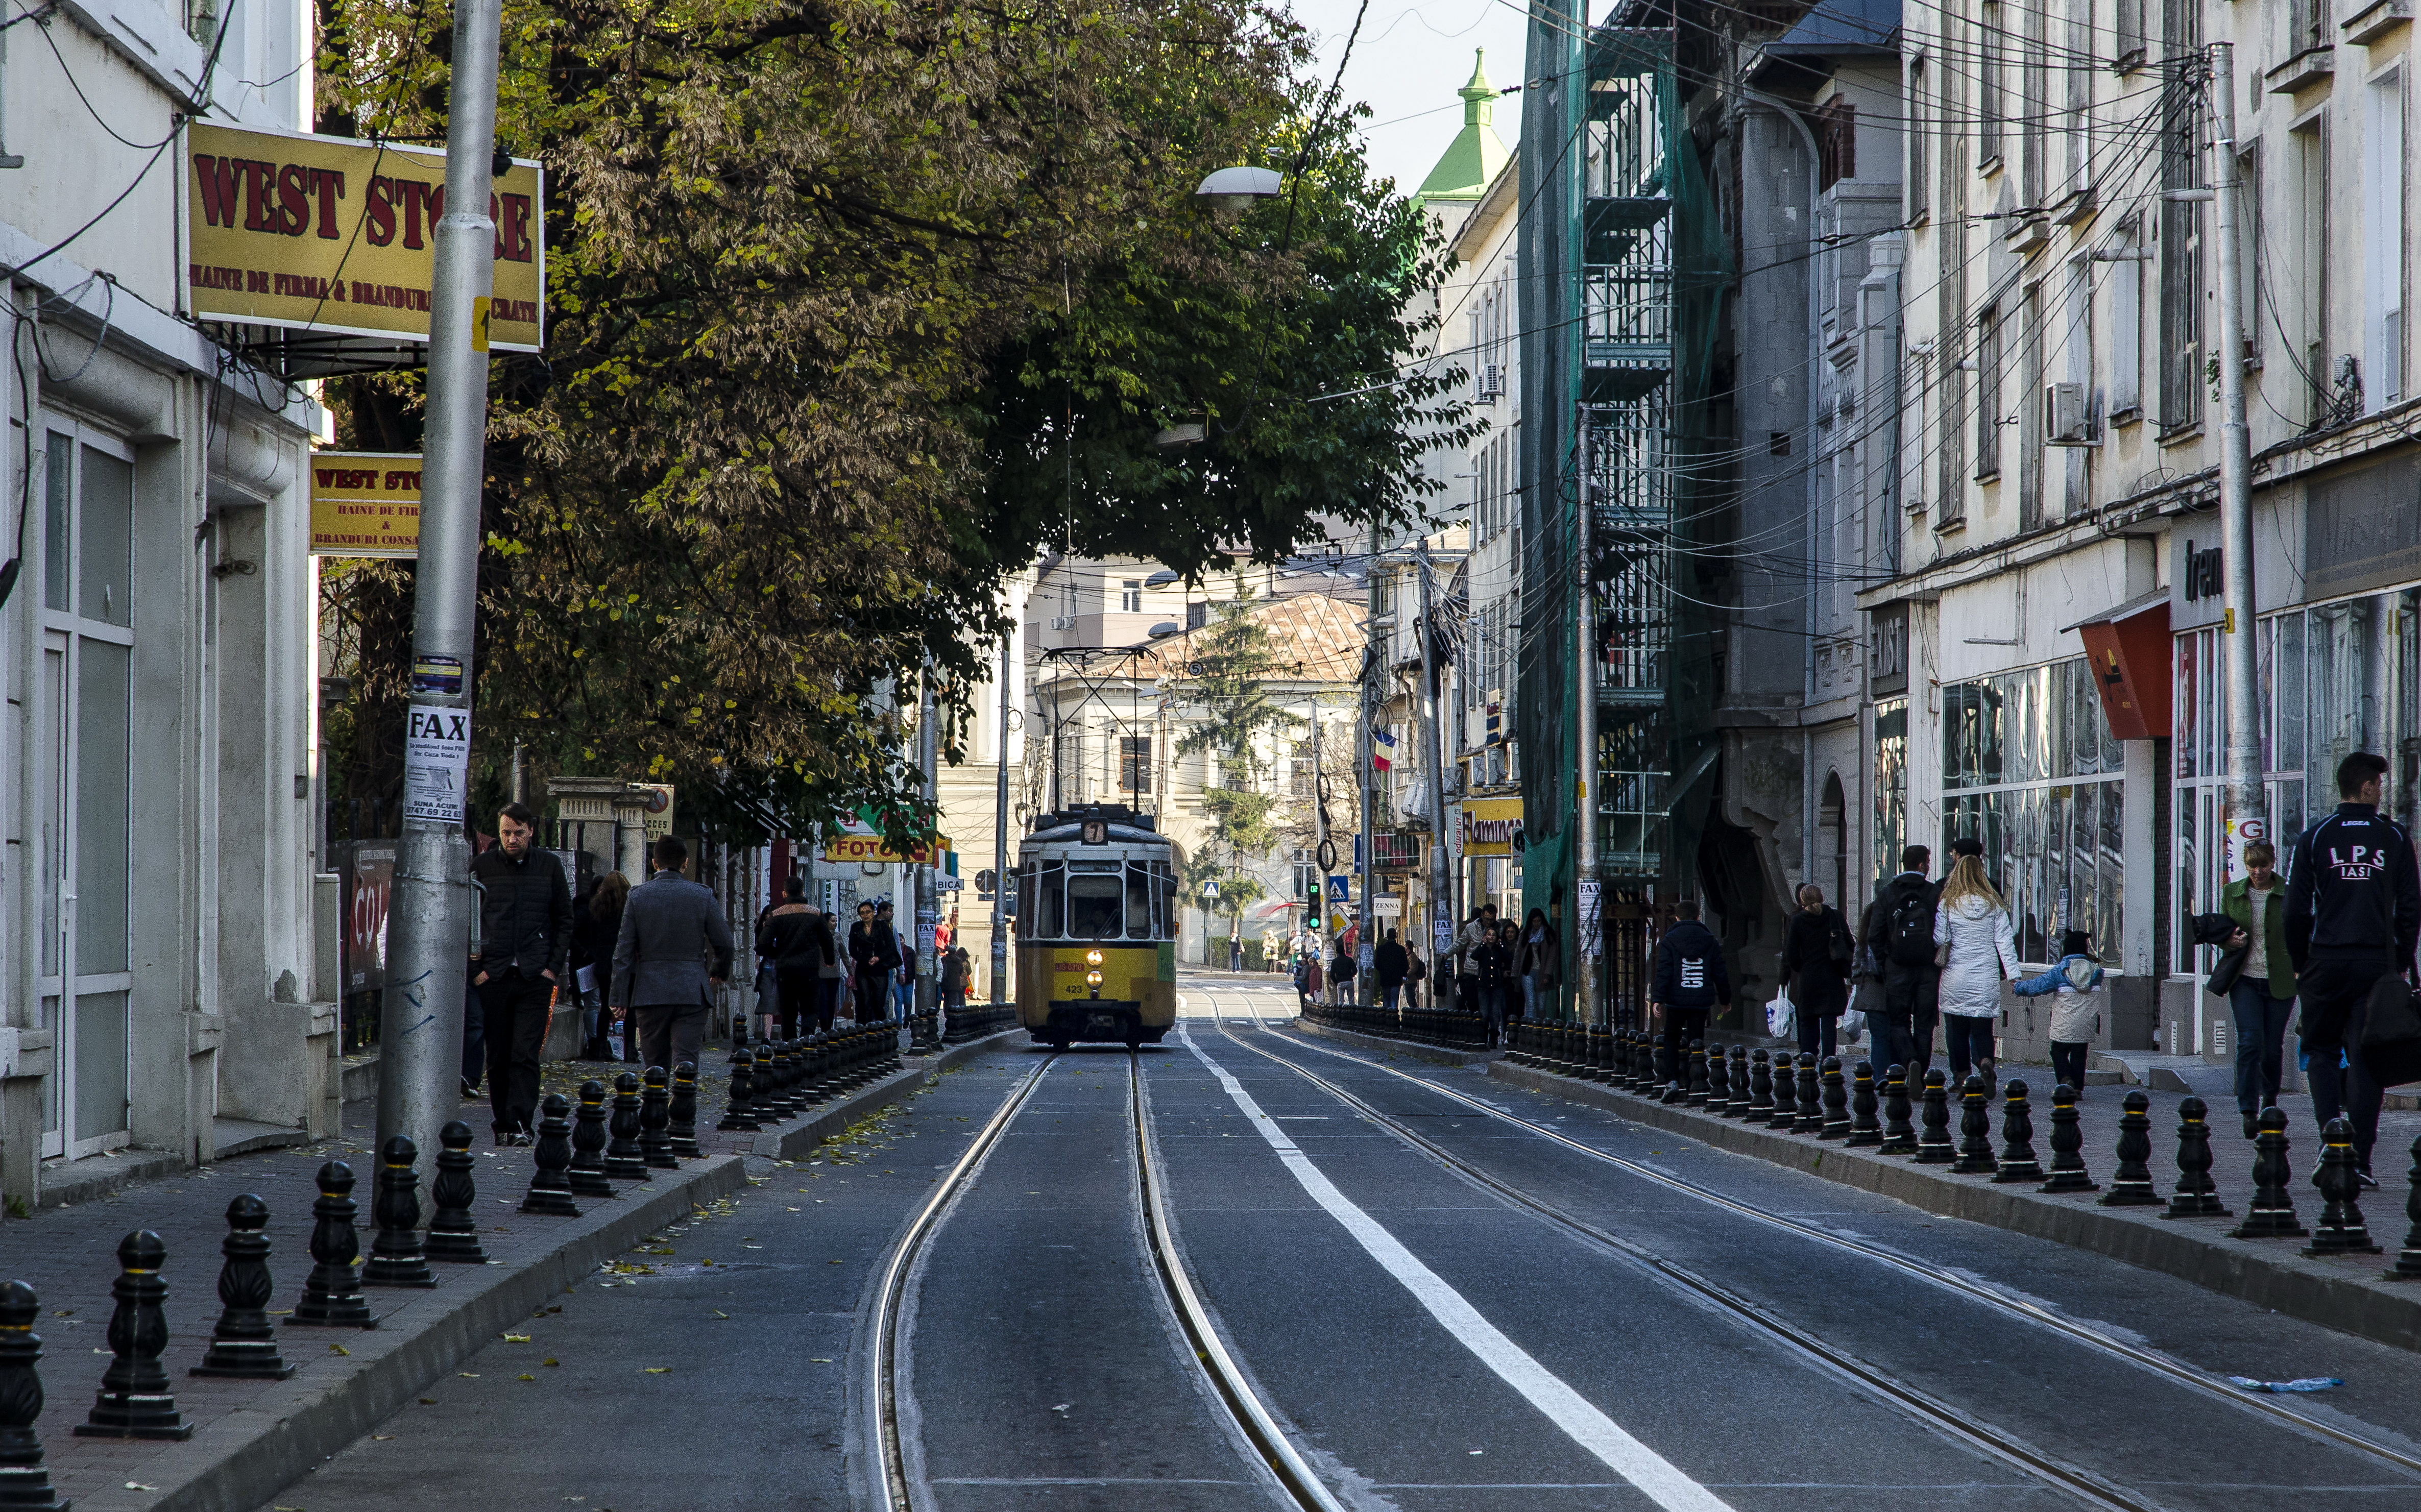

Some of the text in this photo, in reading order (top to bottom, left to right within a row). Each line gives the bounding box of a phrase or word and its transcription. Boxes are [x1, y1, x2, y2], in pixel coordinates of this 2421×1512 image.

[193, 153, 532, 264] WEST STE
[247, 270, 270, 294] DE
[315, 469, 379, 489] WEST
[337, 505, 419, 517] HAINE DE FIR
[382, 520, 391, 530] &
[314, 533, 378, 545] BRANDURI
[409, 712, 467, 741] FAX
[647, 819, 667, 828] CCES
[1090, 823, 1099, 841] 7
[2341, 866, 2370, 877] IASI
[937, 881, 961, 889] BICA
[1580, 884, 1600, 893] FAX
[1066, 985, 1082, 994] 423
